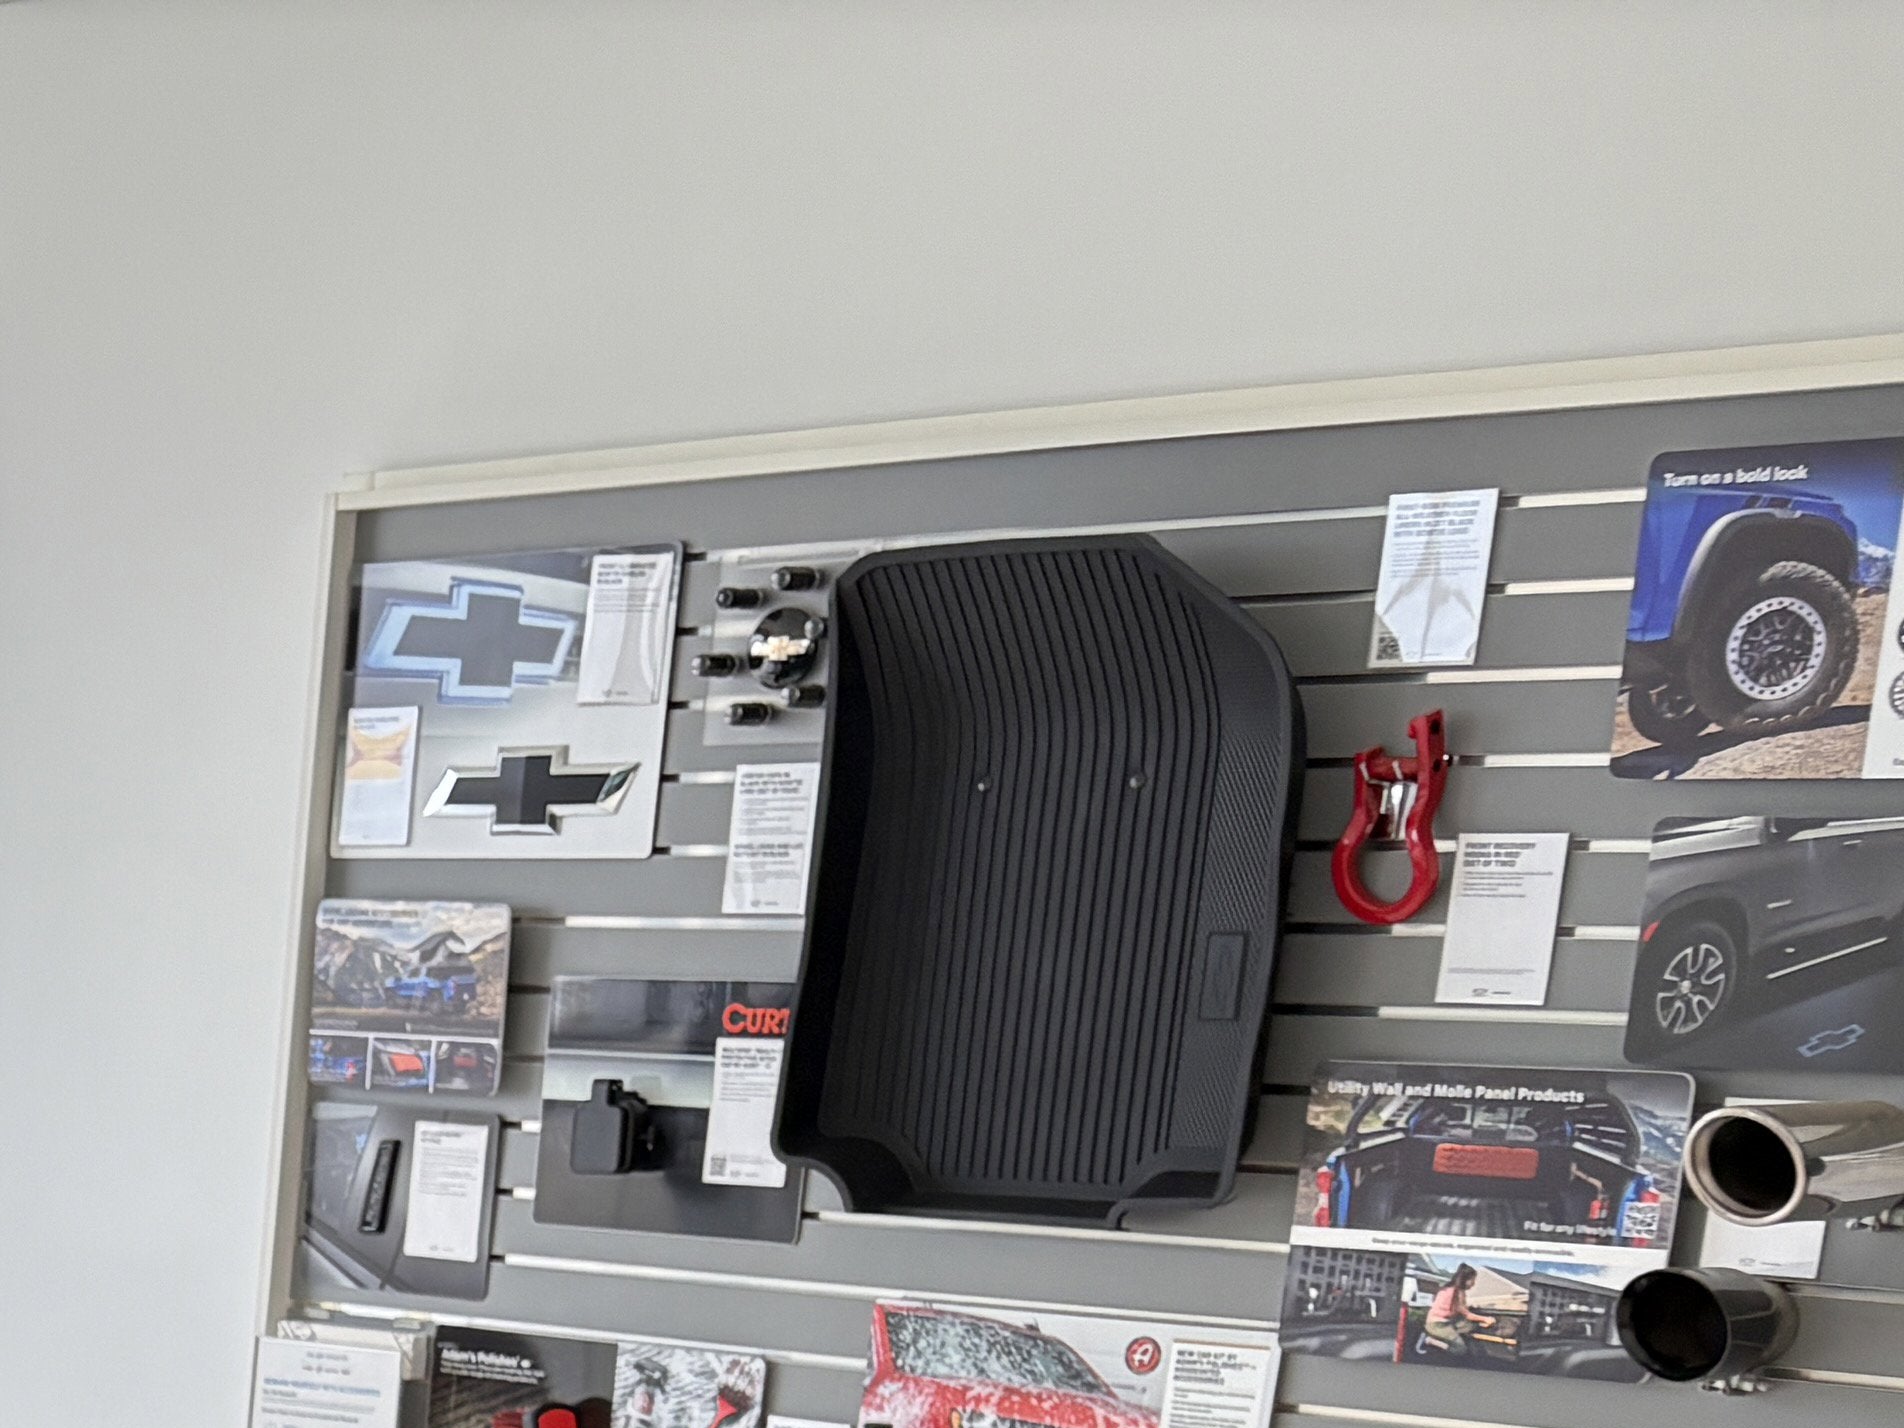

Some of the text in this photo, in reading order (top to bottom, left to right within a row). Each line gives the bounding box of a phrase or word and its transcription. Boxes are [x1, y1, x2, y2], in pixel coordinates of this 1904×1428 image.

[1664, 464, 1809, 488] Turn on a bold look
[1328, 1080, 1370, 1097] Utility
[1373, 1080, 1404, 1097] Wall
[1404, 1083, 1432, 1098] and
[1475, 1084, 1515, 1101] Panel
[1518, 1087, 1585, 1103] Products
